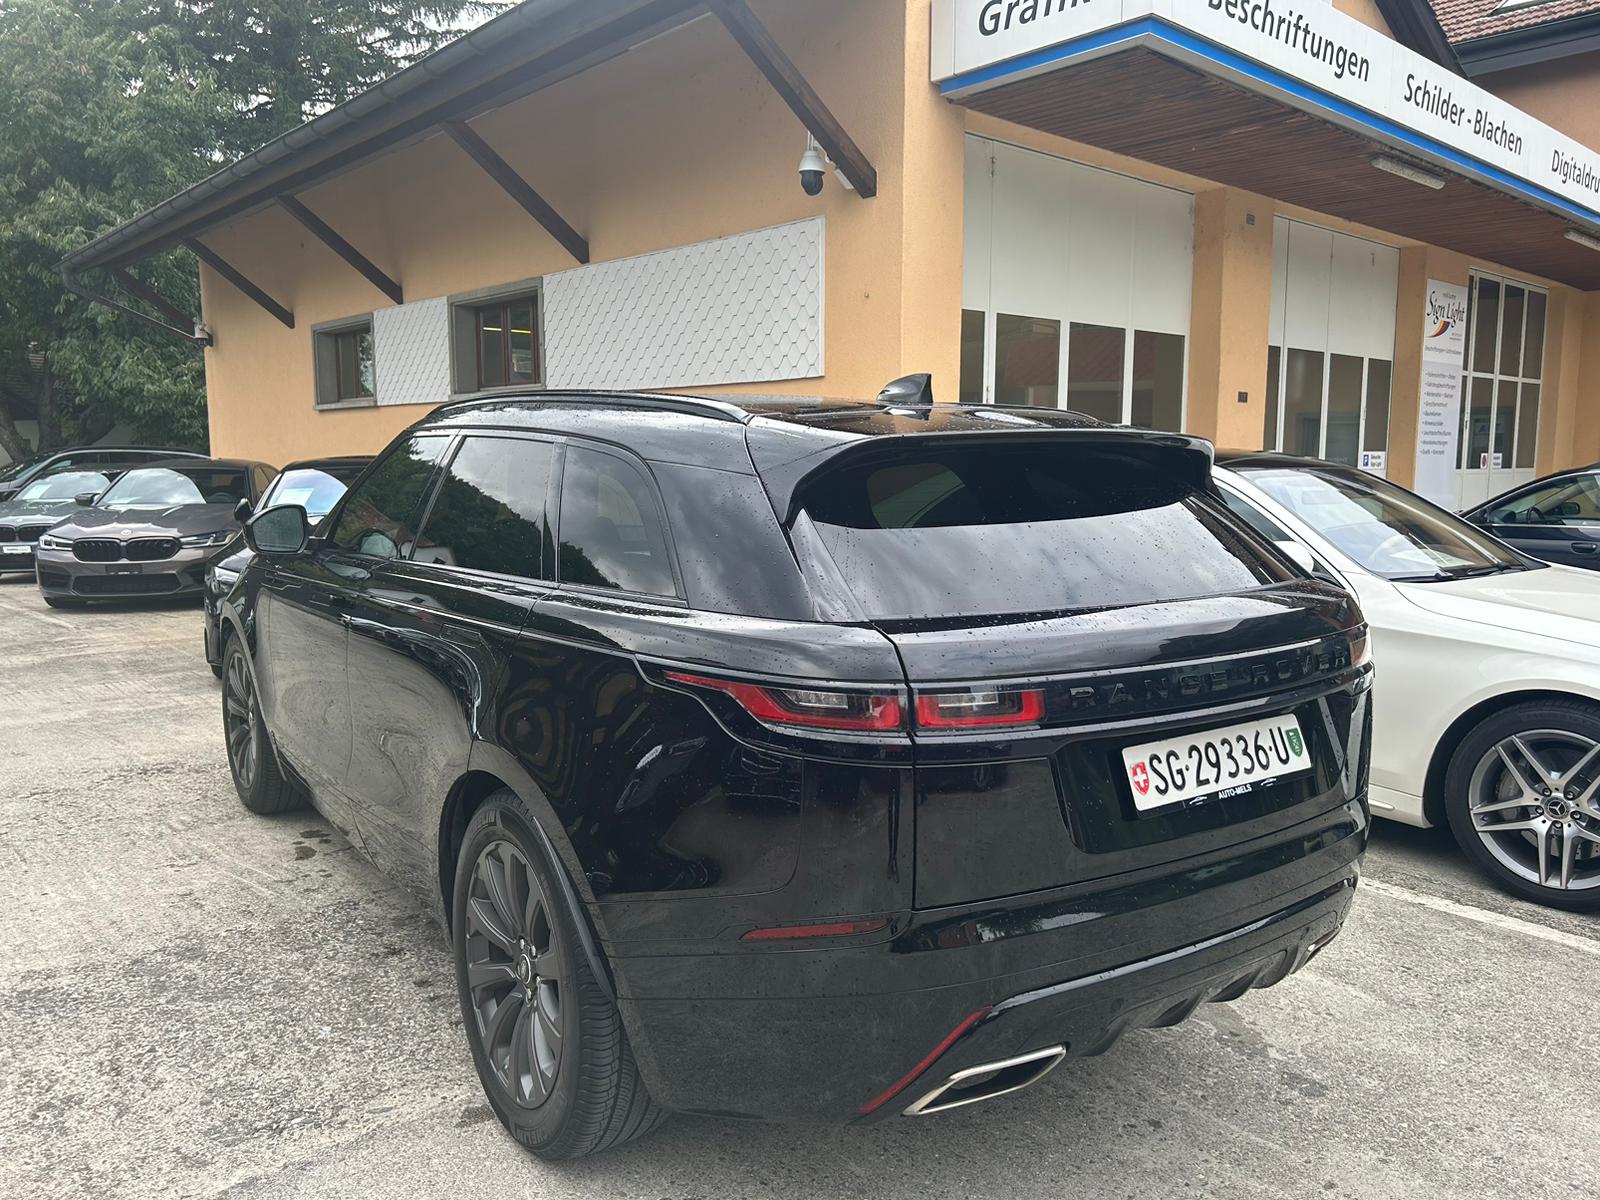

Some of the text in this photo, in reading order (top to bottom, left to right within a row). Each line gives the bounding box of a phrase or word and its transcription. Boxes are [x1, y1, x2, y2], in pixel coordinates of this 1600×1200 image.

[978, 0, 1091, 36] Gra
[1404, 73, 1465, 127] Schilder
[1474, 108, 1523, 156] Blachen
[1427, 291, 1465, 328] Sign Light
[1069, 645, 1347, 706] RANGE ROVER
[1218, 784, 1252, 800] AUTO-MELS
